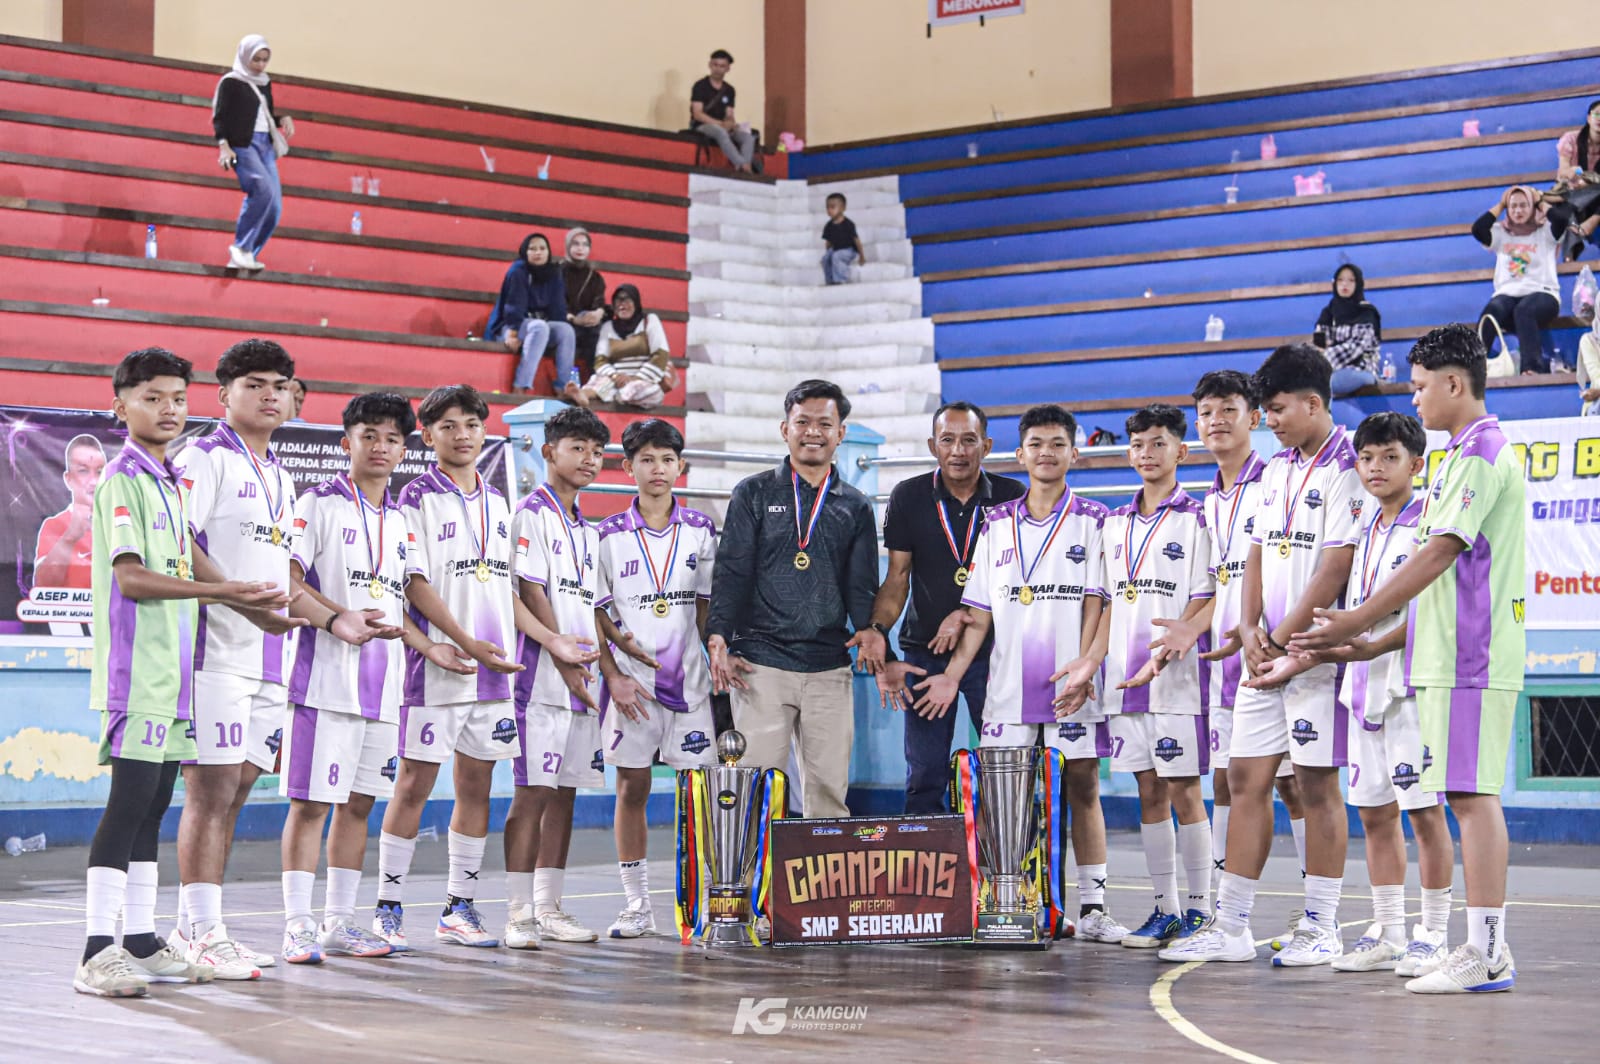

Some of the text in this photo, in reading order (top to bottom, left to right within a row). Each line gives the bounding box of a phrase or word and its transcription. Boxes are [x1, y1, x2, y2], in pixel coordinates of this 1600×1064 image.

[943, 0, 1014, 14] MEROK
[280, 442, 321, 455] ADALAH
[282, 457, 319, 469] KEPADA
[438, 521, 456, 542] JD
[995, 547, 1014, 567] JD
[620, 559, 639, 578] JD
[1010, 584, 1084, 596] RMAH GIGI
[1154, 579, 1177, 591] GIGI
[36, 591, 68, 601] ASEP
[141, 720, 168, 748] 19
[215, 722, 243, 748] 10
[420, 722, 435, 745] 6
[543, 751, 563, 775] 27
[327, 762, 339, 787] 8
[784, 849, 959, 904] CHAMPIONS
[849, 899, 896, 913] KATEGORI
[801, 912, 945, 937] SMP SEDERAJAT
